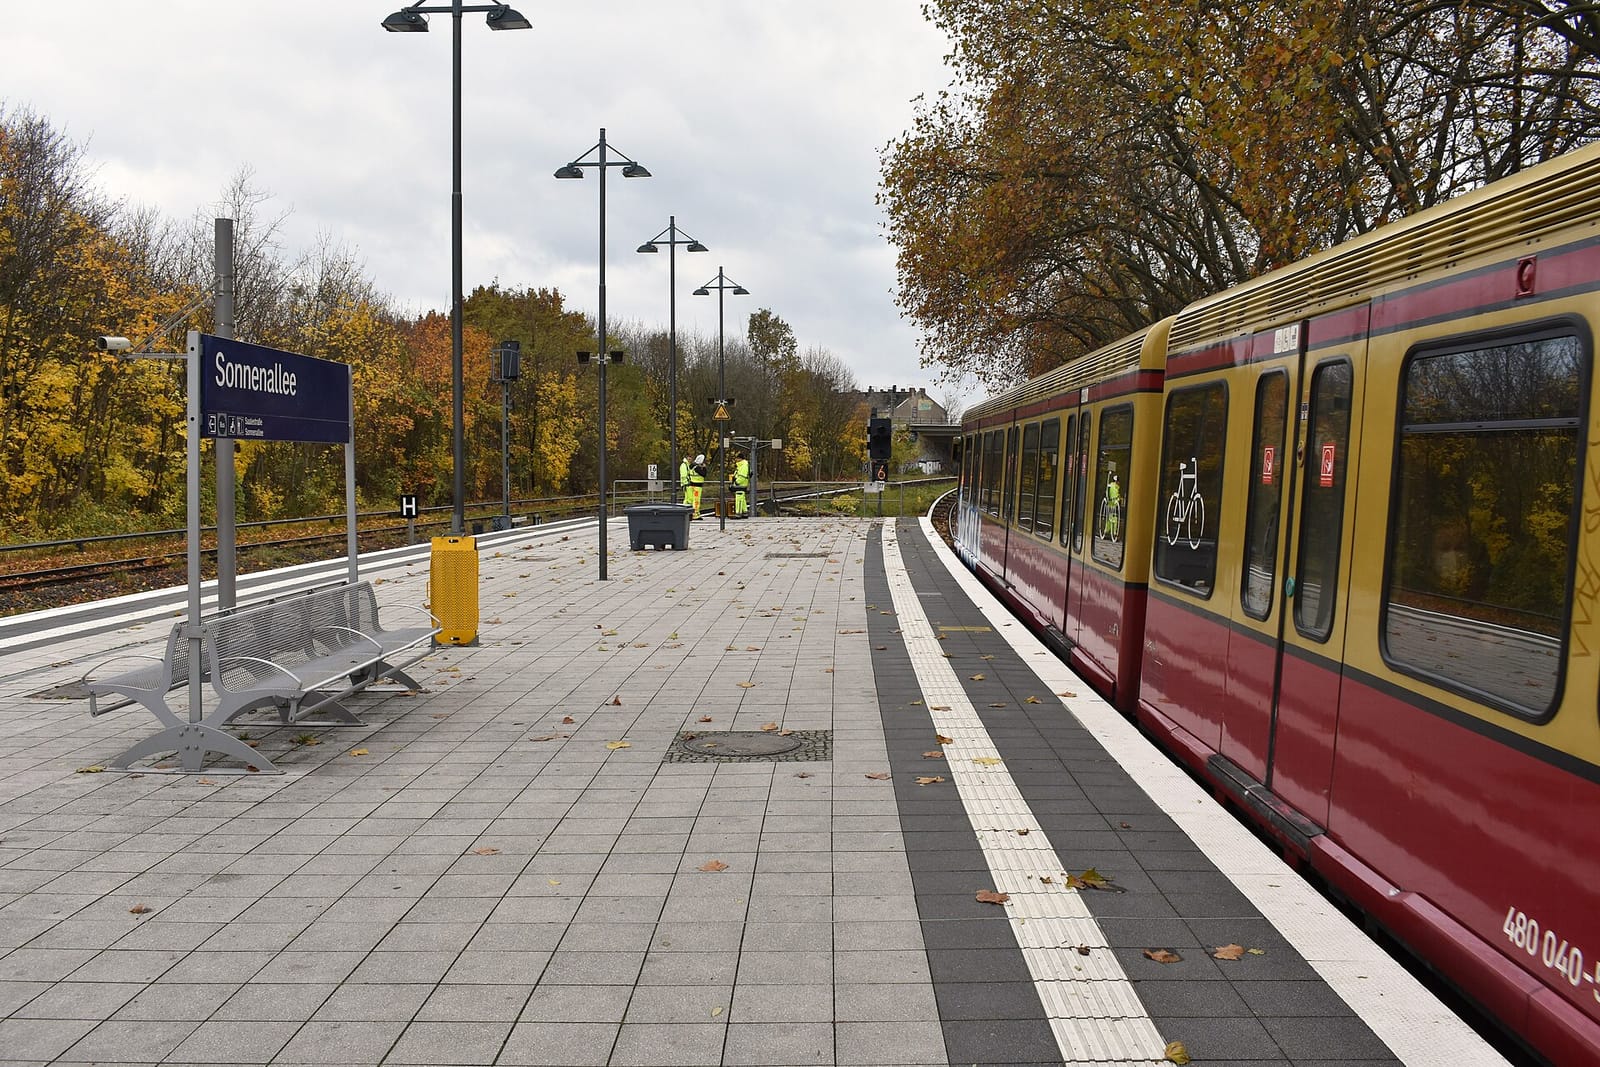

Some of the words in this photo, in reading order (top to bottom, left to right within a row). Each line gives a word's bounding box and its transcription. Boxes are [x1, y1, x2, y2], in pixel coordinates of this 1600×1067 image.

[215, 351, 297, 396] Sonnenallee
[877, 464, 886, 480] 6
[402, 496, 416, 516] H
[1503, 905, 1540, 957] 480
